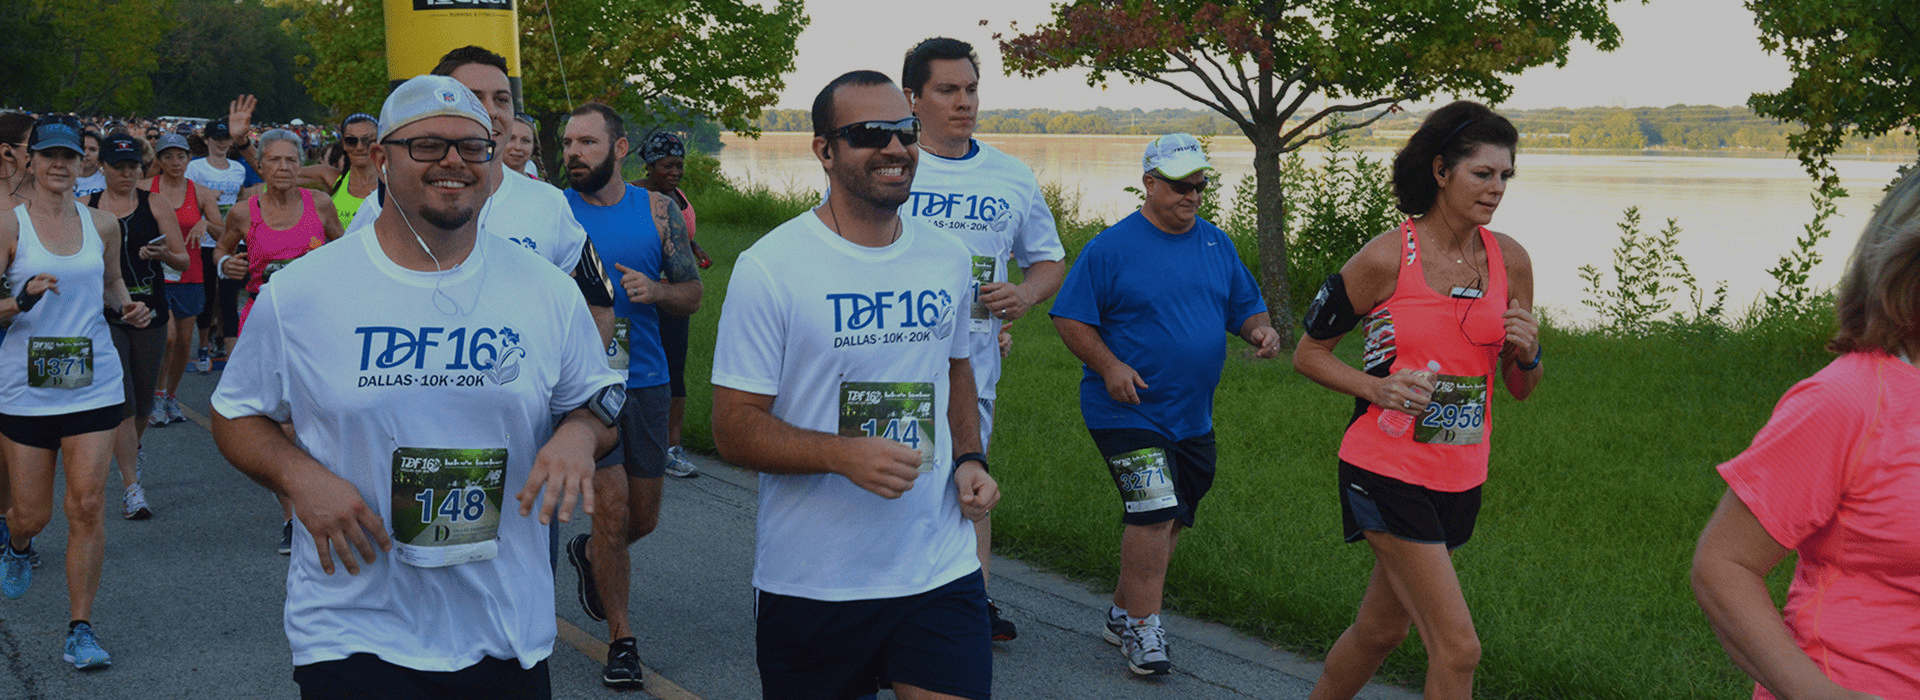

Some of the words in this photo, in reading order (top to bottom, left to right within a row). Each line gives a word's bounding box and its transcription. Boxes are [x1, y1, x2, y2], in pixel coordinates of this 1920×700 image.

[834, 334, 877, 348] DALLAS
[883, 332, 904, 344] 10K
[908, 331, 931, 342] 20K
[33, 357, 86, 376] 1371
[358, 374, 412, 387] DALLAS
[420, 375, 449, 386] 10K
[457, 375, 485, 386] 20K
[1422, 402, 1484, 430] 2958
[861, 418, 921, 450] 144
[1121, 467, 1165, 492] 3271
[415, 488, 487, 524] 148
